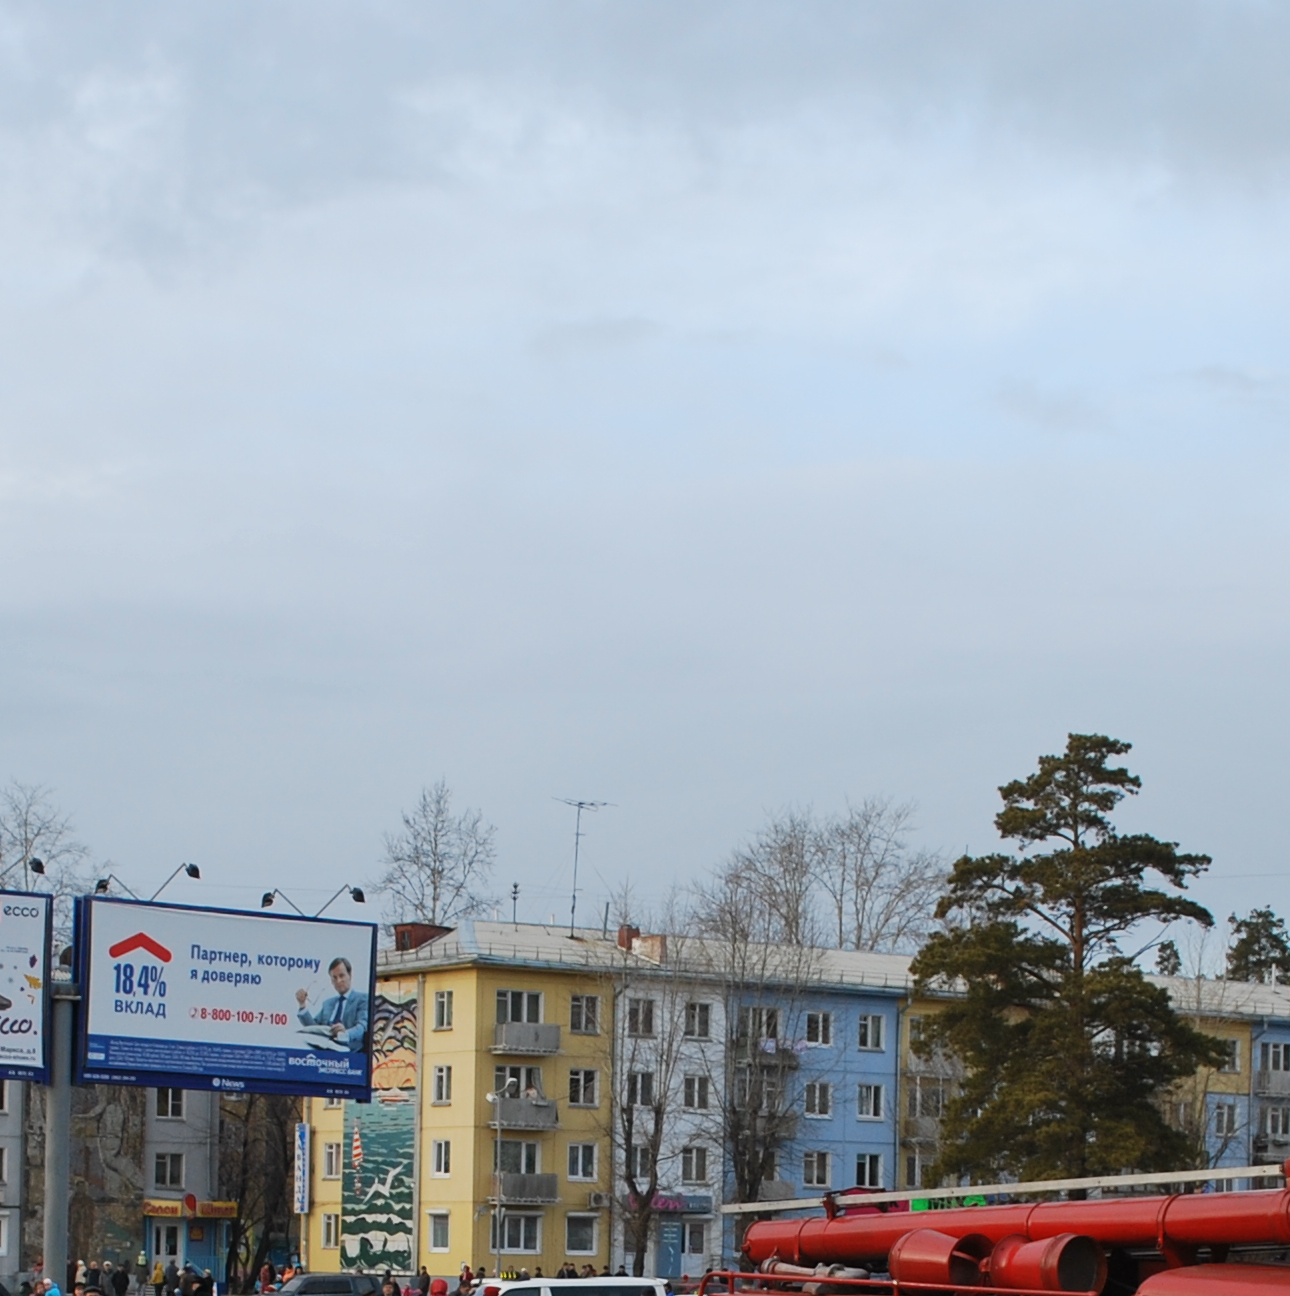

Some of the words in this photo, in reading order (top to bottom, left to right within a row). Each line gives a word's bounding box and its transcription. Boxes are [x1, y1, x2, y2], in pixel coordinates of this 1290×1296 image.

[3, 905, 39, 918] ecco
[191, 944, 252, 967] Партнер,
[258, 953, 320, 973] которому
[113, 963, 167, 998] 18,4%
[190, 969, 198, 980] я
[201, 969, 262, 987] доверяю
[114, 999, 166, 1019] ВКЛАД
[200, 1007, 287, 1026] 8-800-100-7-100
